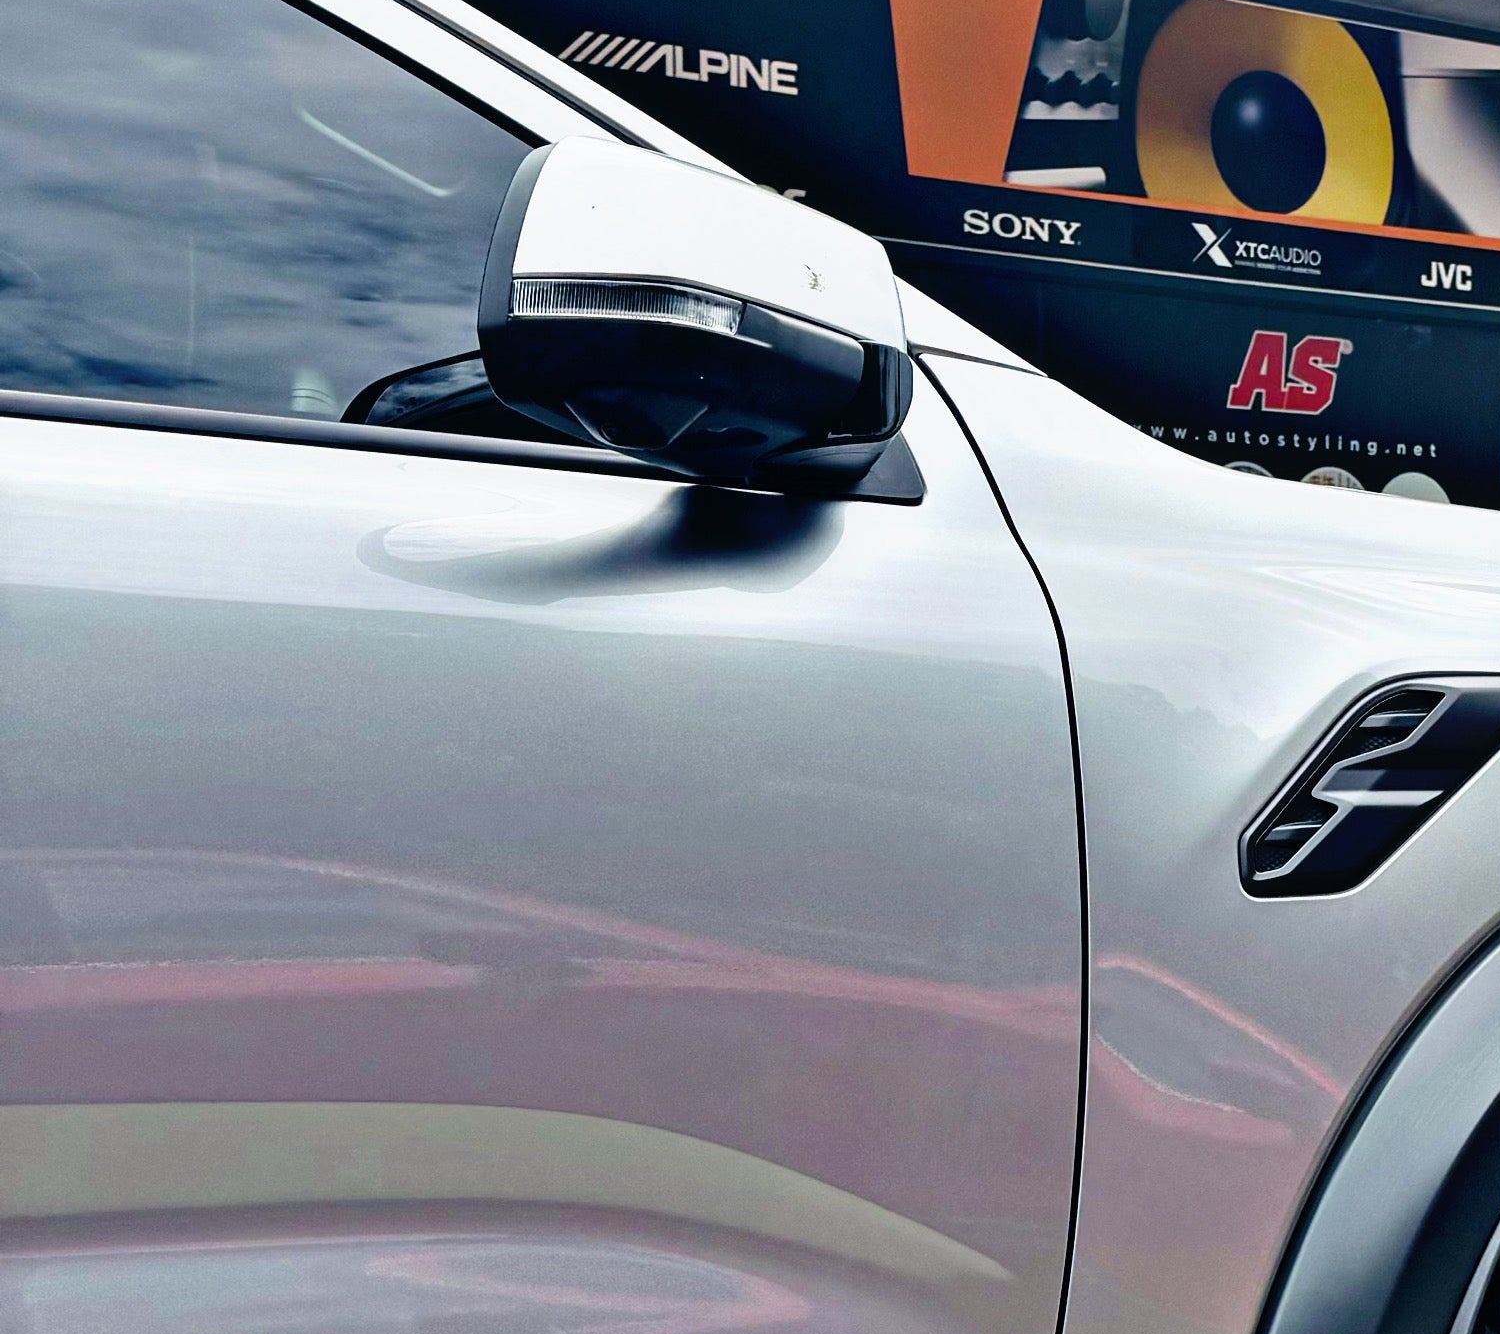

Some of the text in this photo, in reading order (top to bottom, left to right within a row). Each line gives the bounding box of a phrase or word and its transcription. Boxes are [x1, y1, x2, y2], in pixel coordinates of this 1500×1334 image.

[636, 43, 798, 95] ALPINE
[962, 208, 1081, 246] SONY
[1234, 239, 1323, 267] XTCAUDIO
[1420, 261, 1473, 292] JVC
[1226, 329, 1344, 416] AS
[1132, 423, 1438, 458] ww.autostyling.net
